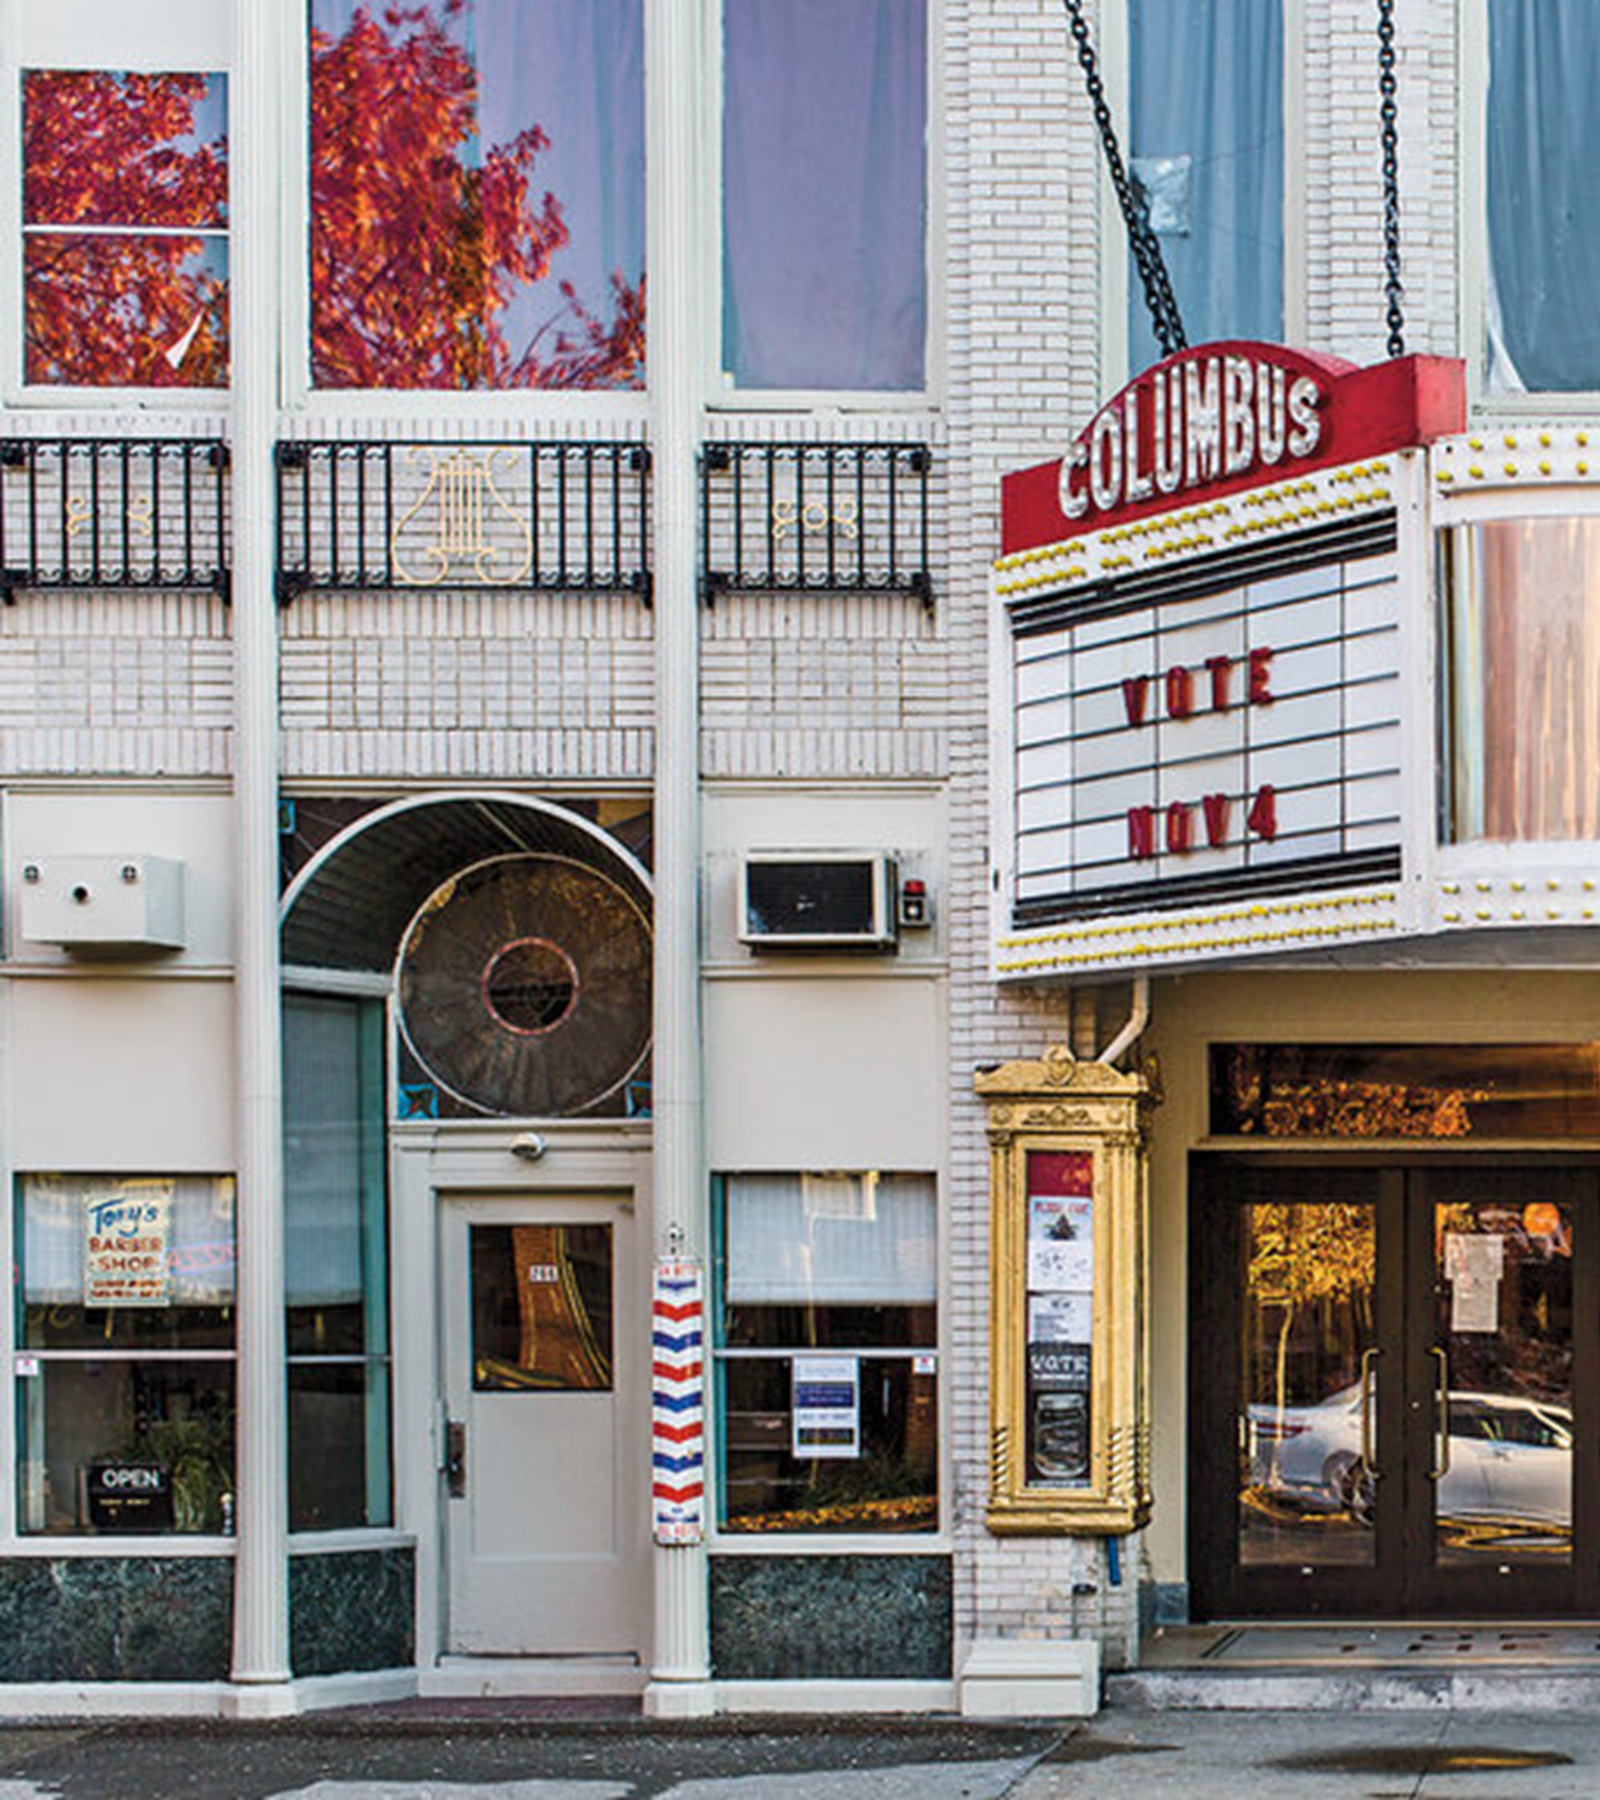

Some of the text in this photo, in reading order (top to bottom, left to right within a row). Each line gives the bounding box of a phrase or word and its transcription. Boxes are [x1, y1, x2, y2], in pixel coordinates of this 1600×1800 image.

[1057, 354, 1323, 521] COLUMBUS
[1121, 646, 1275, 729] VOTE
[1127, 783, 1277, 860] NOV 4
[88, 1197, 159, 1238] Tony's
[88, 1236, 163, 1253] BARBER
[1031, 1354, 1088, 1373] VOTE
[101, 1467, 159, 1489] OPEN
